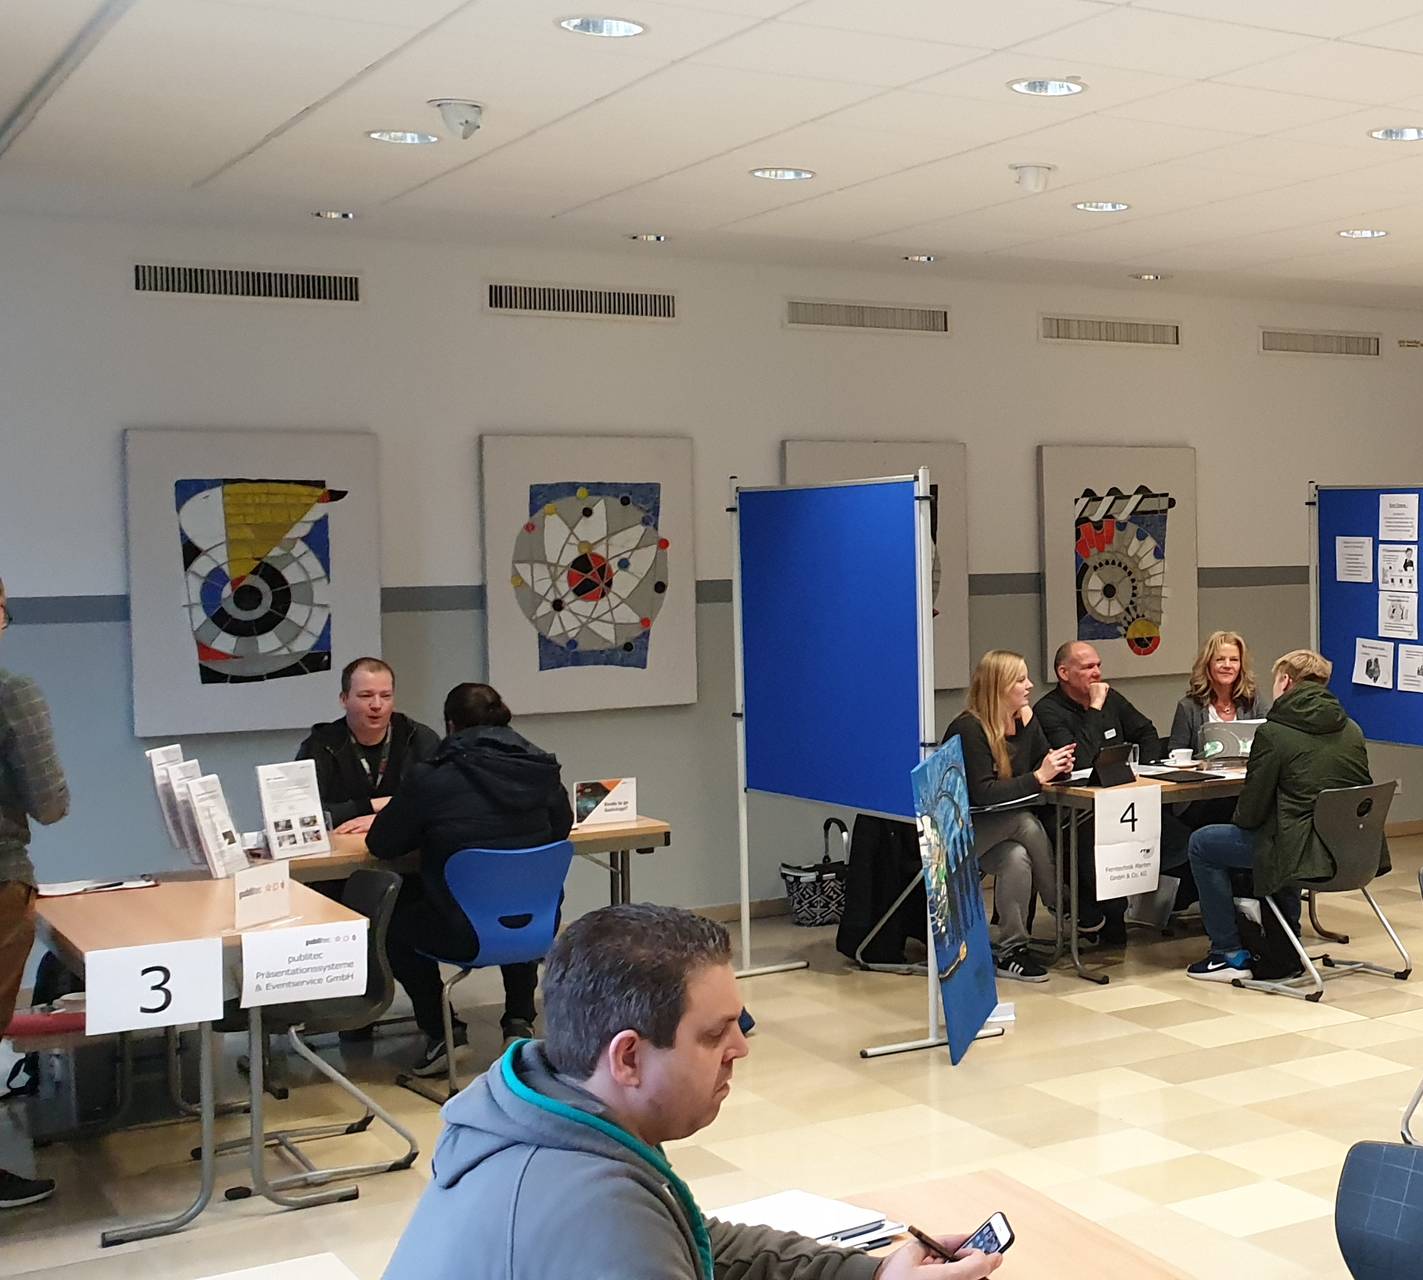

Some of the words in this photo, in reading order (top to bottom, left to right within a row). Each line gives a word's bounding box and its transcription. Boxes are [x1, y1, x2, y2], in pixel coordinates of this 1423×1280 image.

[1120, 802, 1138, 832] 4
[288, 952, 324, 965] publitec
[256, 961, 354, 980] Präsentationssysteme
[140, 966, 172, 1013] 3
[255, 984, 262, 992] &
[265, 978, 324, 991] Eventservice
[326, 974, 354, 984] GmbH
